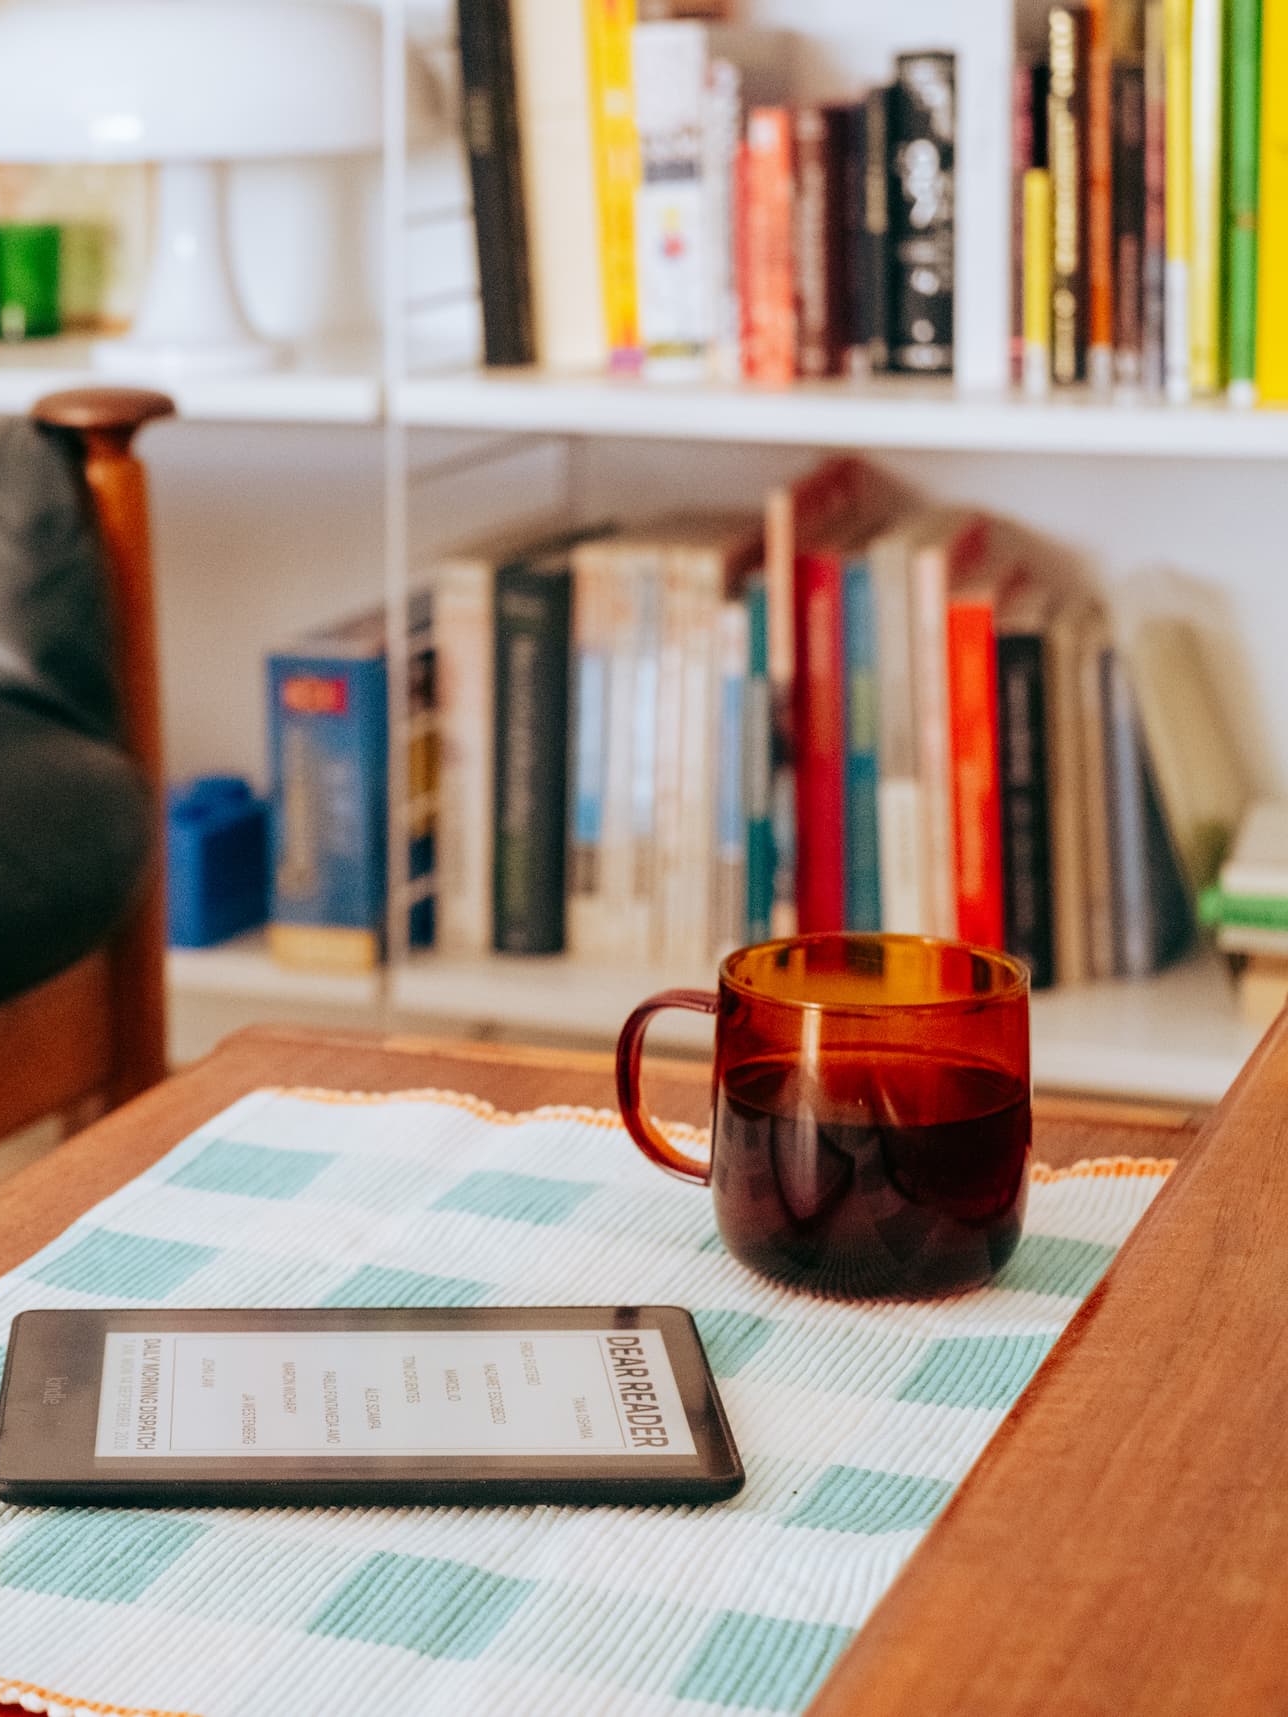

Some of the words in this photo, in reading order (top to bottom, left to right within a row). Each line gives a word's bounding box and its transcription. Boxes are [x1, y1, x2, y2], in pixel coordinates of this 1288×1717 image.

[142, 1338, 161, 1361] DAILY
[606, 1336, 650, 1378] DEAR
[42, 1375, 69, 1405] kindle
[139, 1363, 160, 1404] MORNING
[136, 1405, 158, 1450] DISPATCH
[618, 1382, 670, 1448] READER
